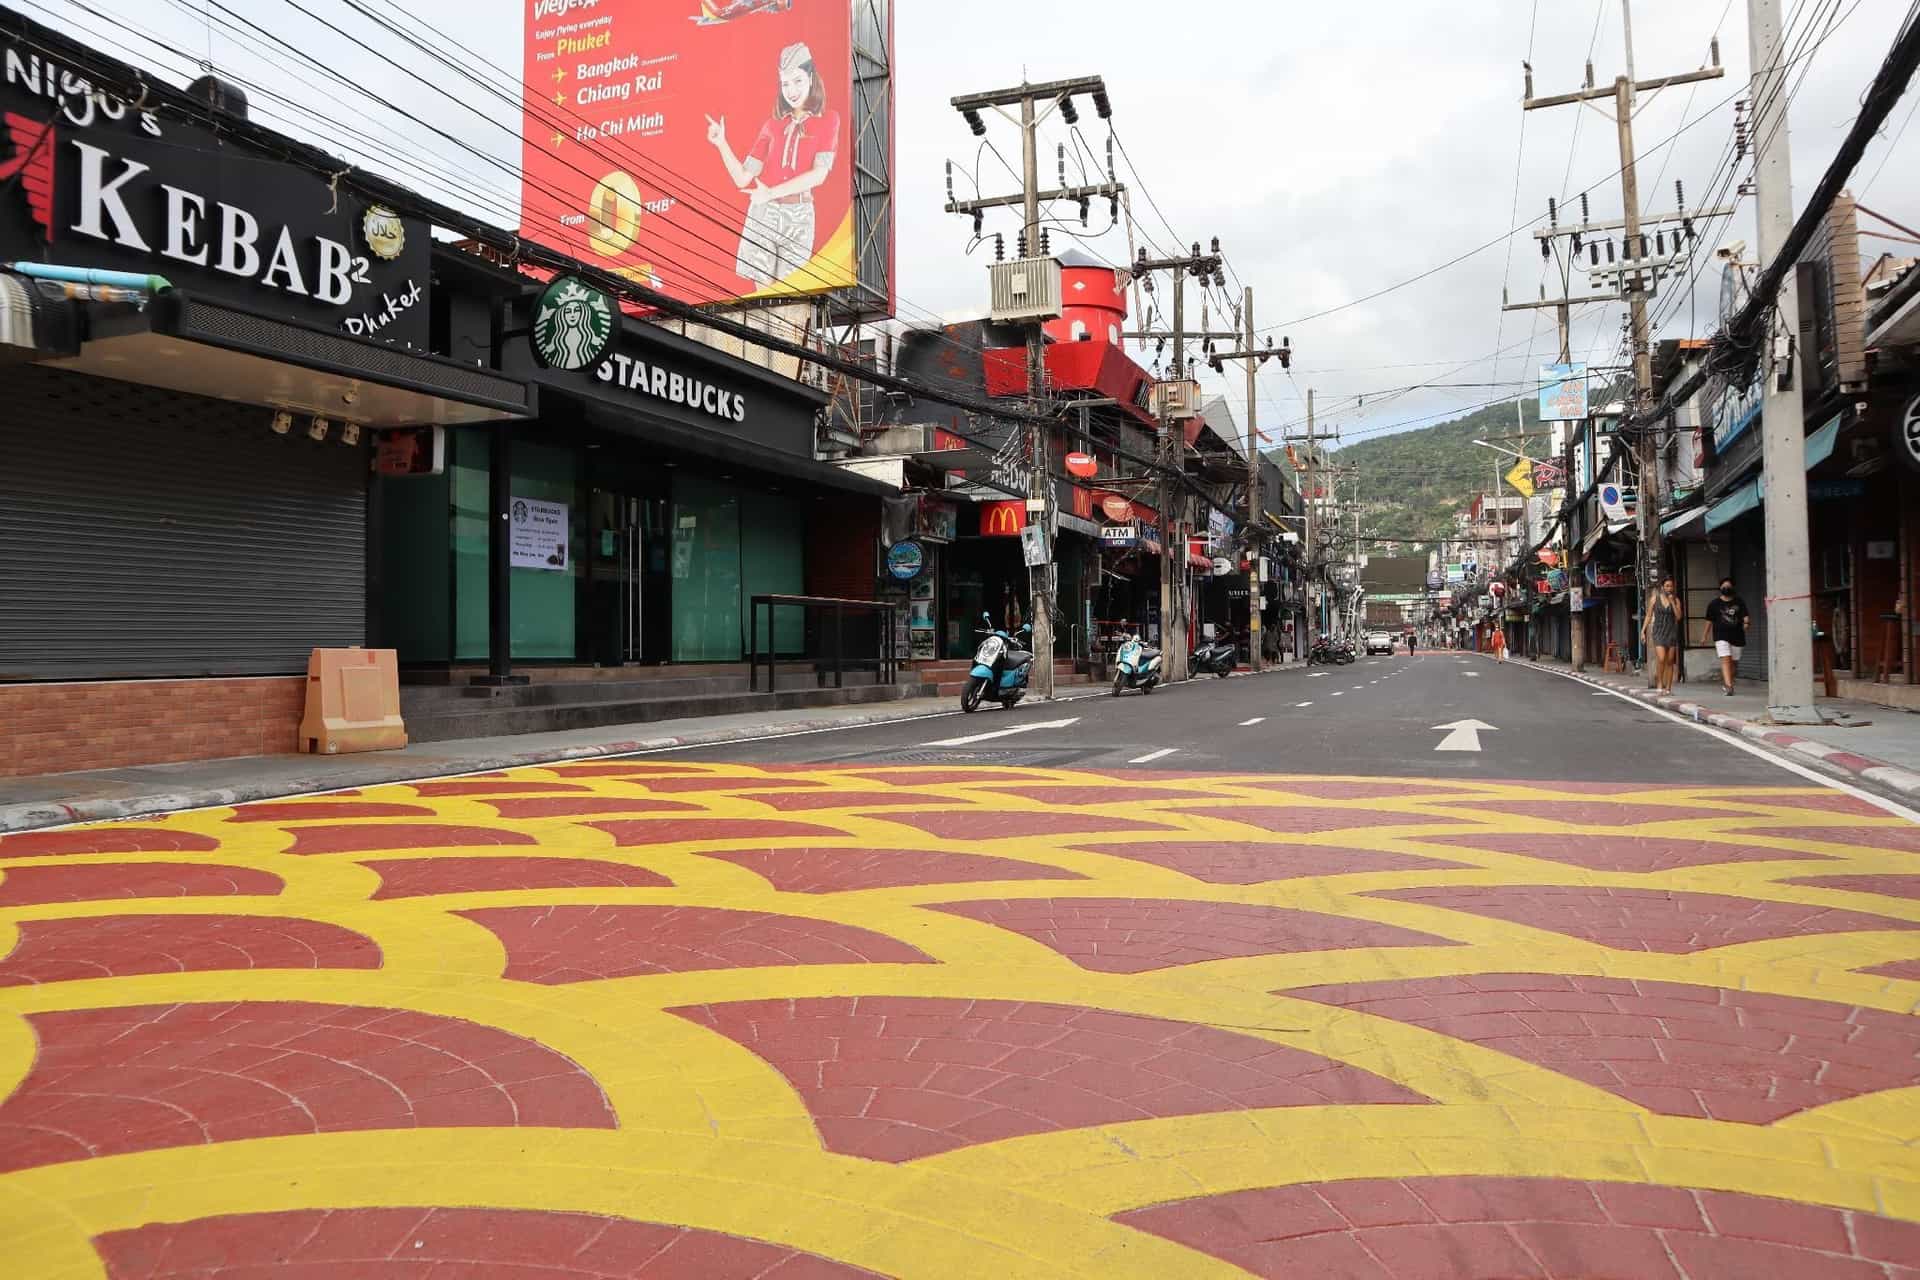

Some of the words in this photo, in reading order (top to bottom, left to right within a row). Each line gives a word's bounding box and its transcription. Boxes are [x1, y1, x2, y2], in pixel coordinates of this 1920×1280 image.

[557, 30, 611, 56] Phuket
[576, 53, 639, 80] Bangkok
[576, 83, 631, 105] Chiang
[635, 71, 663, 94] Rai
[576, 126, 597, 141] Ho
[600, 118, 624, 137] Chi
[627, 111, 664, 133] Minh
[597, 353, 745, 423] STARBUCKS
[1105, 528, 1129, 537] ATM
